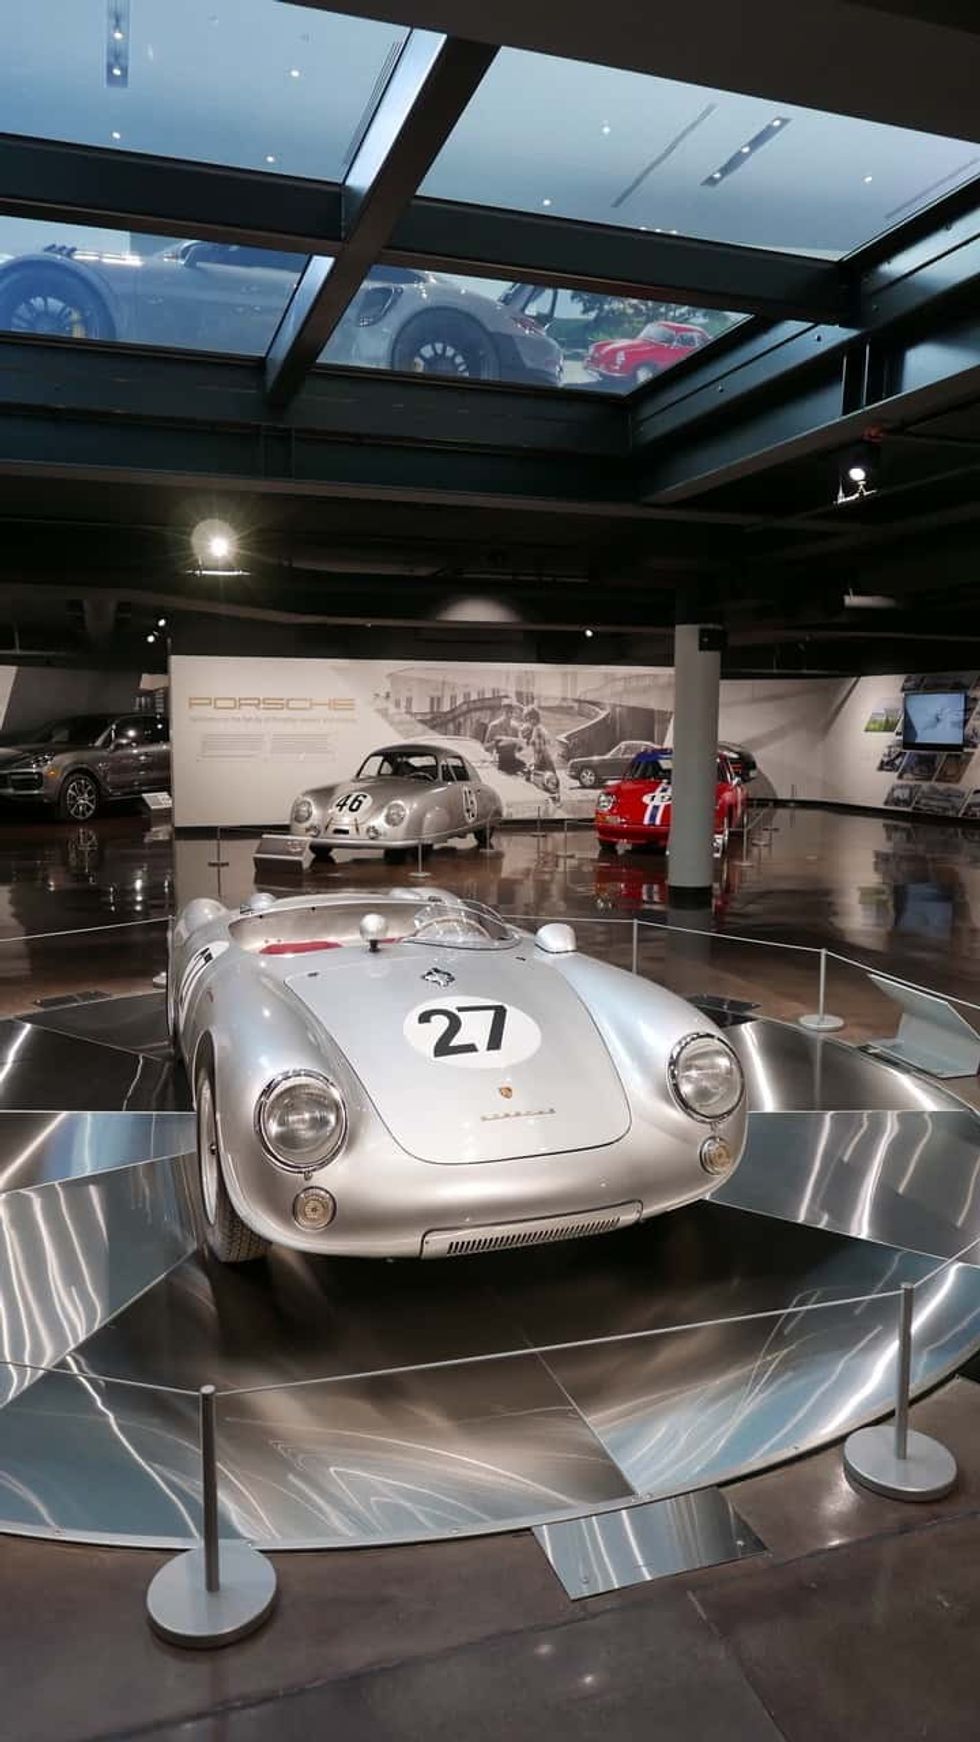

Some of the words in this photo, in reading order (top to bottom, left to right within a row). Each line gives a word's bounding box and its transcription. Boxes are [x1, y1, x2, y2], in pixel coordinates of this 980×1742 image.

[188, 697, 356, 710] PORSCHE
[336, 793, 367, 813] 46
[418, 1004, 507, 1058] 27
